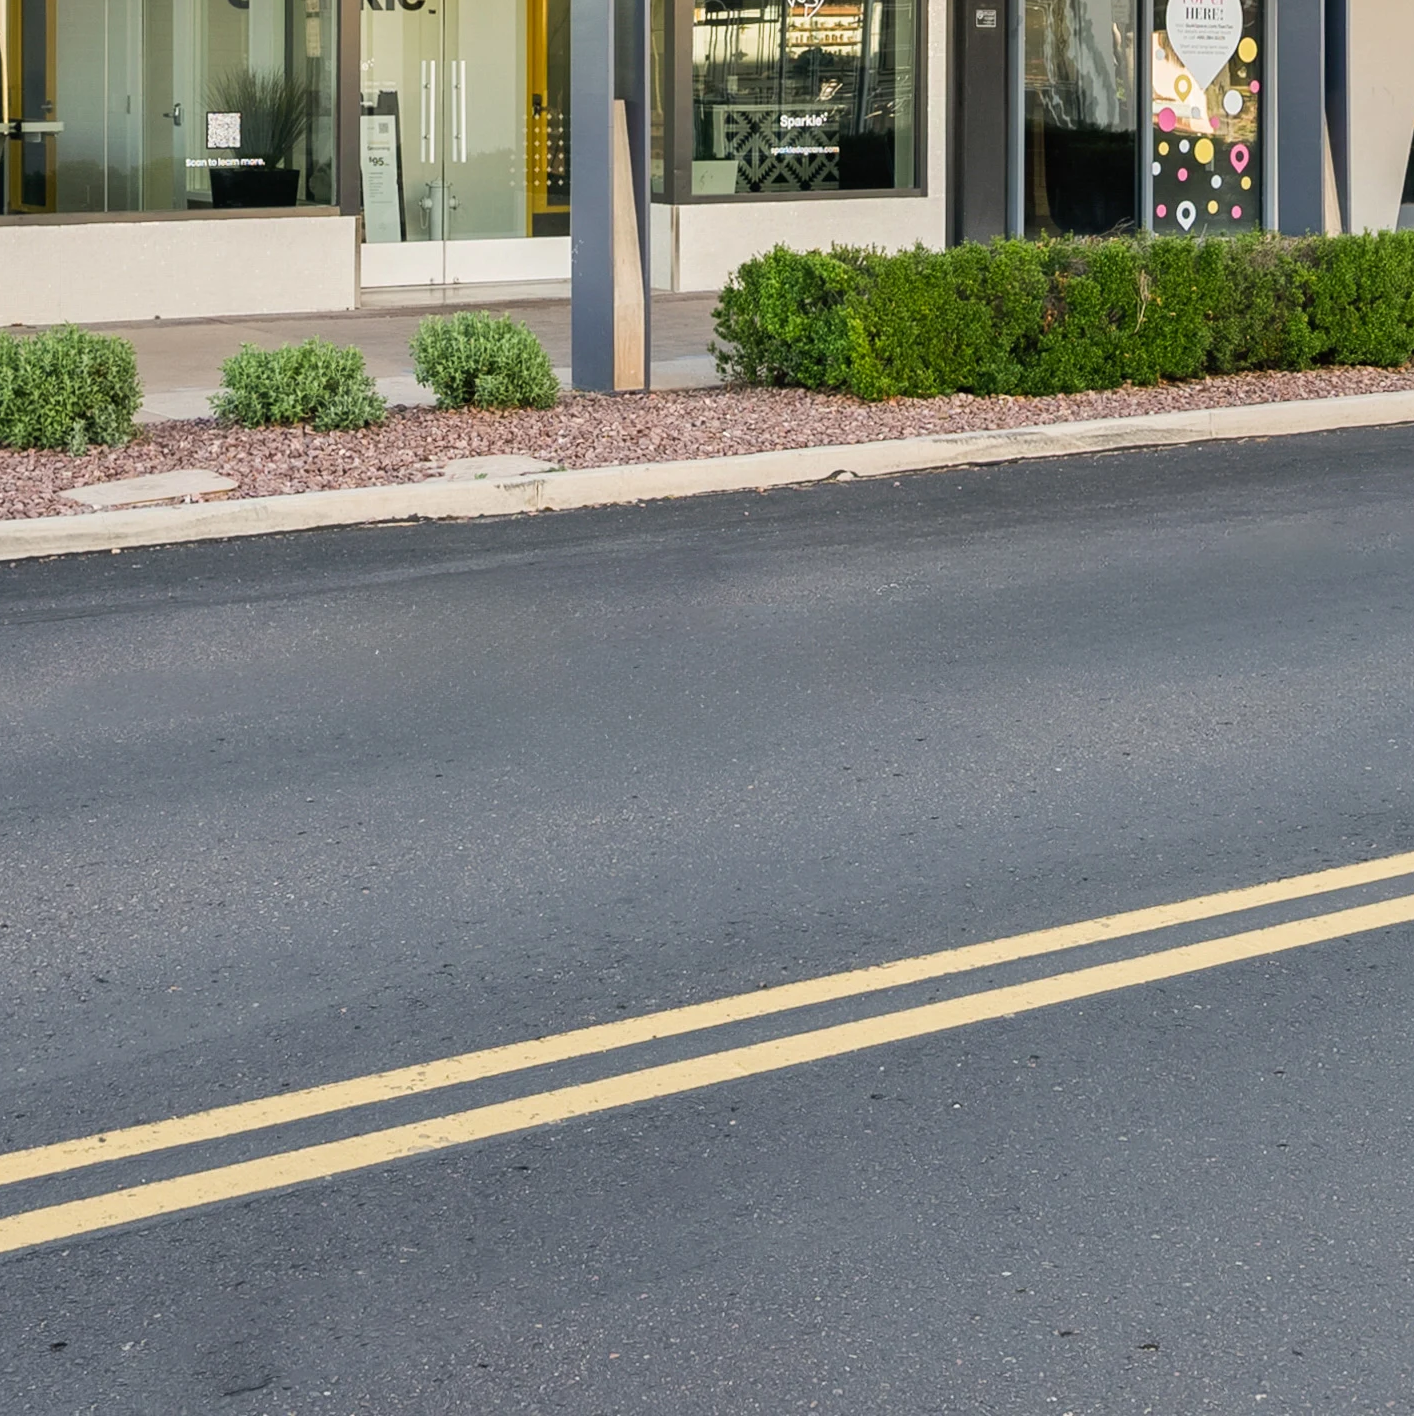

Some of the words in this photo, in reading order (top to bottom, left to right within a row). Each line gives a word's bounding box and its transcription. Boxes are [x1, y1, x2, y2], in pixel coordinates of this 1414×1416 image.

[1185, 7, 1224, 21] HERE!
[780, 114, 823, 130] Sparkle
[186, 158, 207, 167] Scan
[208, 158, 217, 166] to
[218, 157, 239, 166] learn
